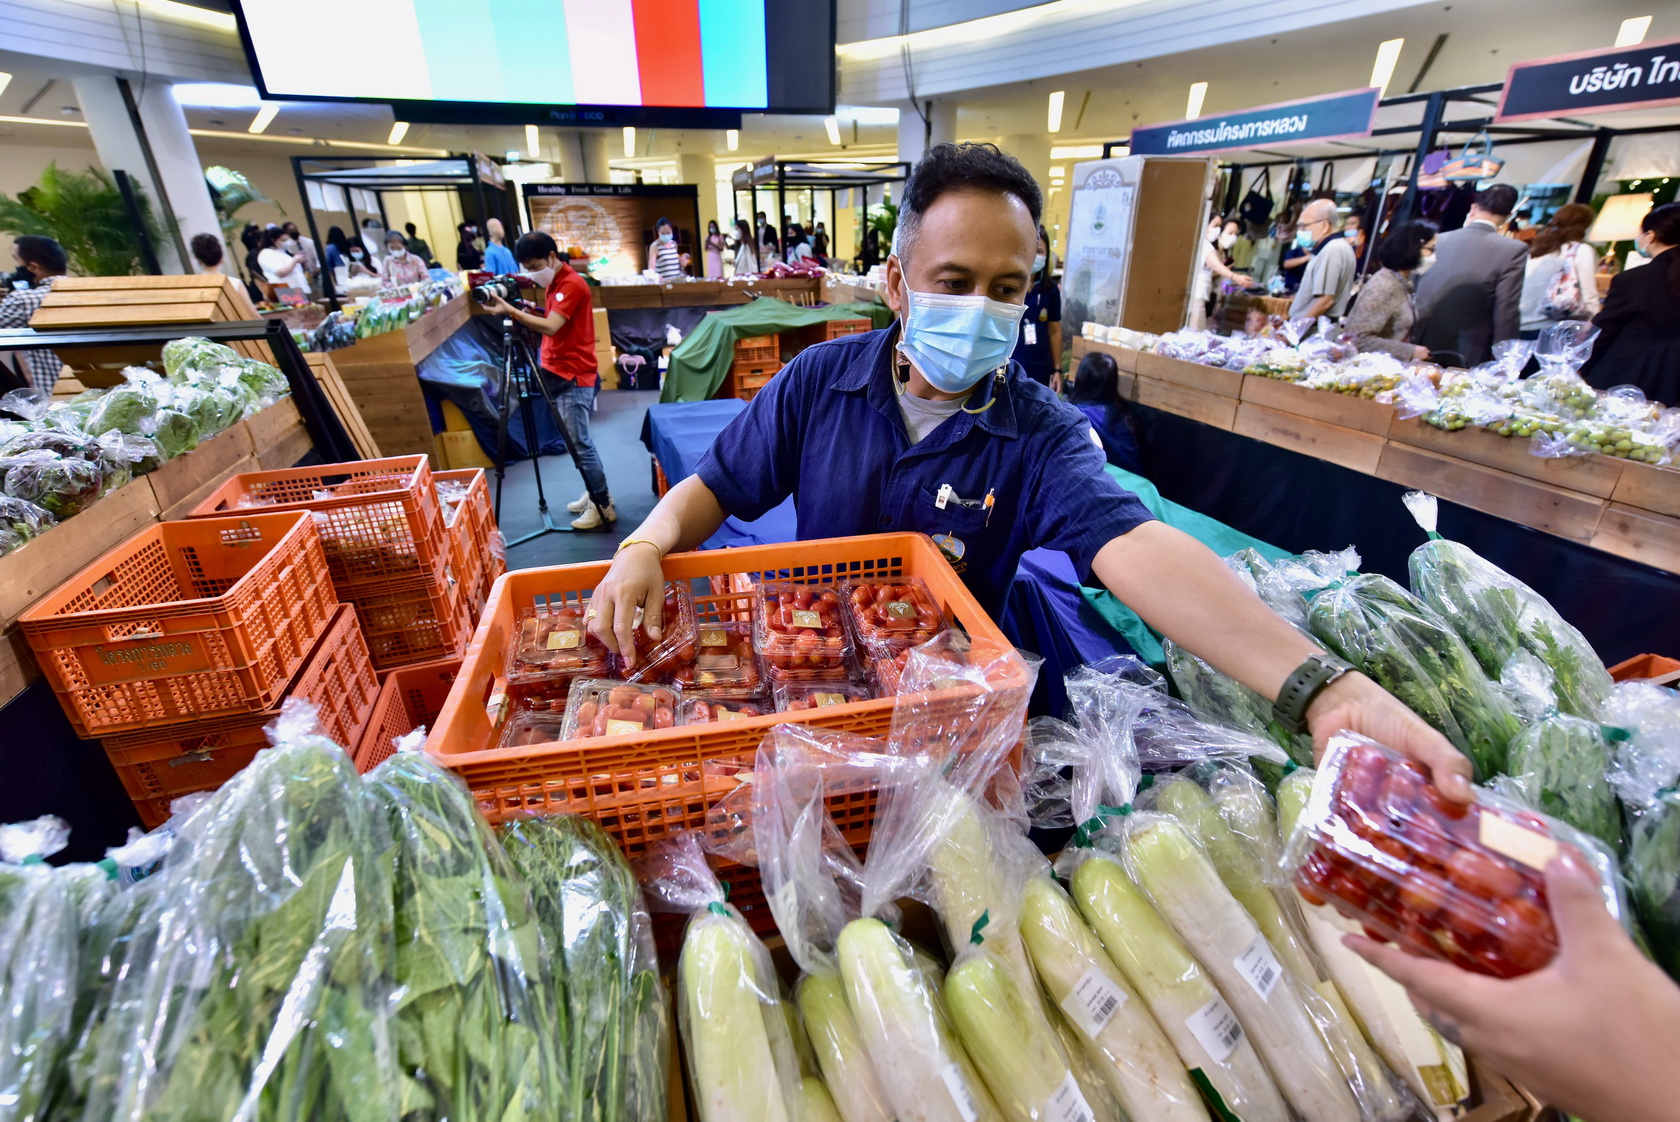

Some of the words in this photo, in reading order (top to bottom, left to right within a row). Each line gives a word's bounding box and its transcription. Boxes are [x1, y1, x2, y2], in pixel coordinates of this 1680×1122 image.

[1569, 62, 1643, 95] บริษัท
[1647, 55, 1680, 85] ไท
[1167, 114, 1308, 148] หัตถกรรมโครงการหลวง
[537, 185, 566, 195] Healthy
[571, 186, 590, 194] Food
[593, 186, 613, 194] Good
[618, 186, 632, 194] Life
[95, 641, 193, 666] โครงการหลวง
